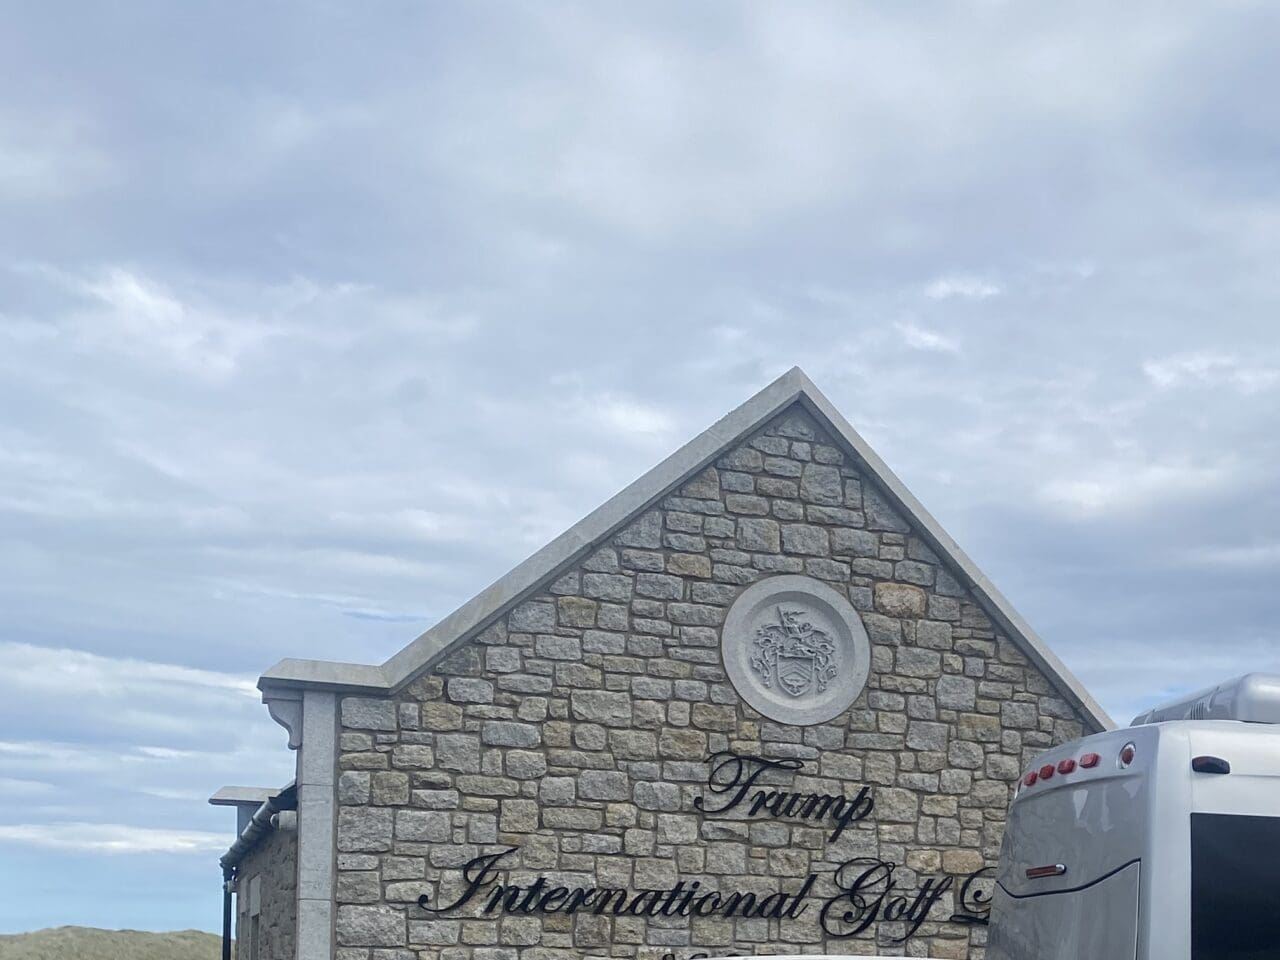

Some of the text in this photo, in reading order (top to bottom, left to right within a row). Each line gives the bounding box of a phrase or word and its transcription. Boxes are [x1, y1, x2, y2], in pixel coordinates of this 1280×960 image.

[694, 751, 875, 843] Trump
[418, 847, 819, 920] International
[820, 857, 953, 942] Golf
